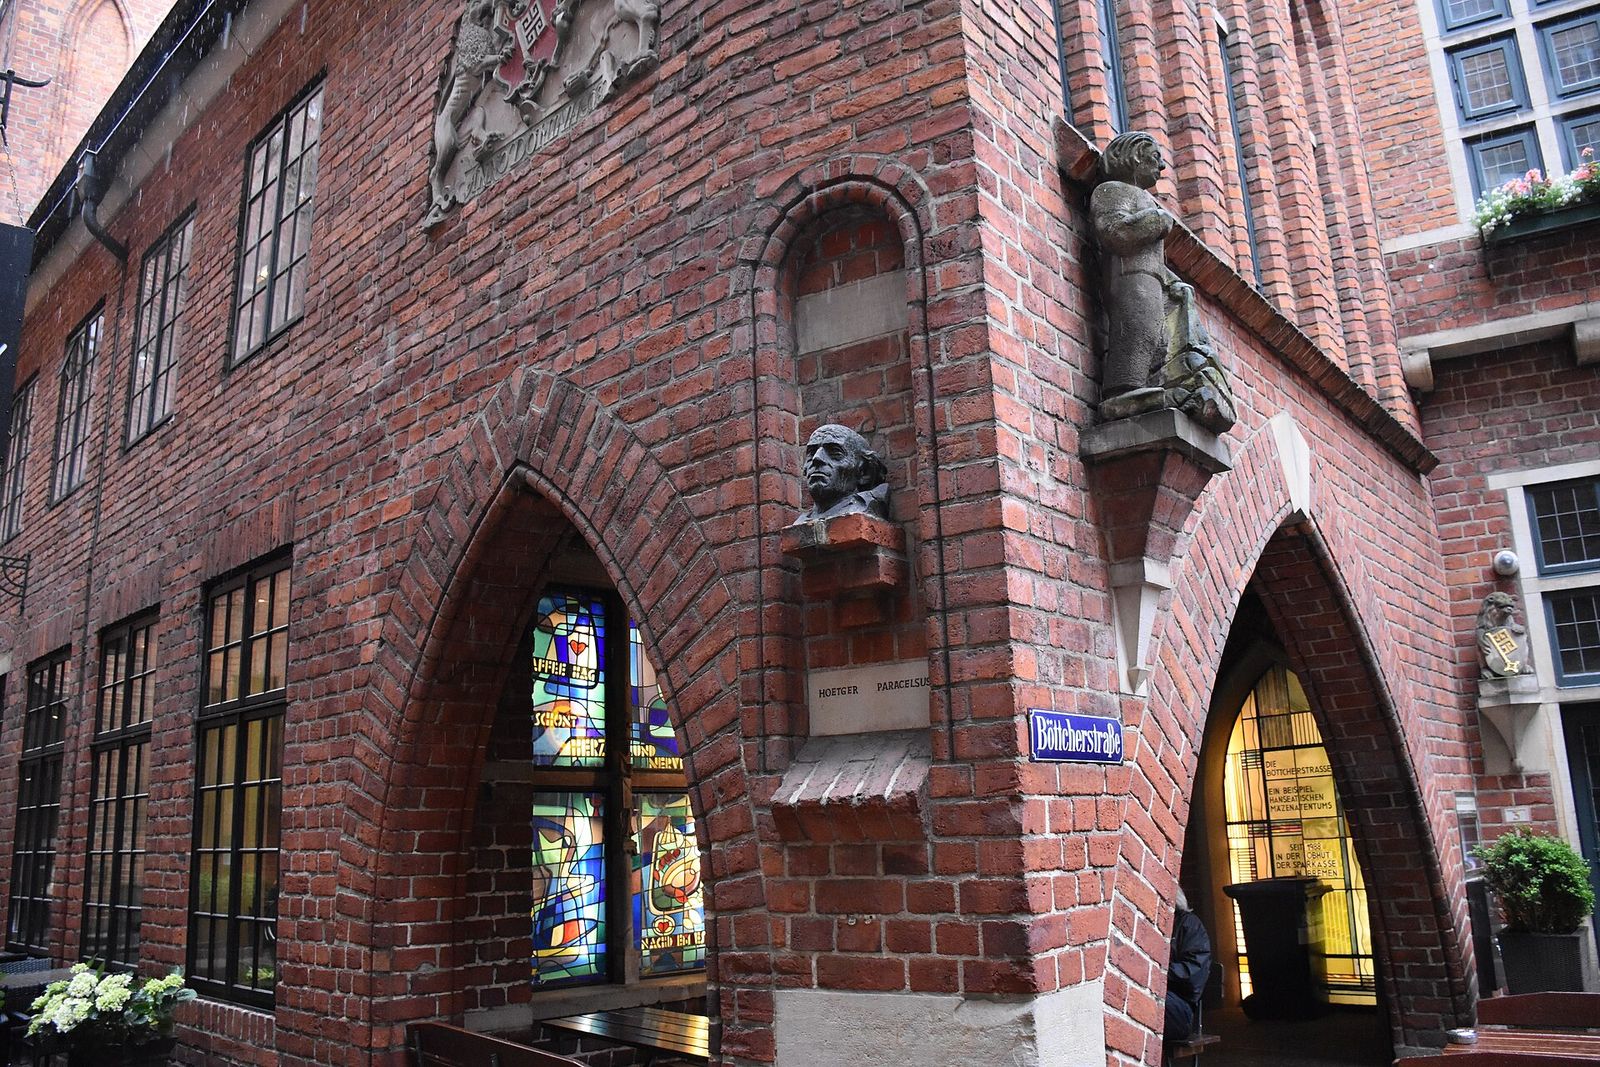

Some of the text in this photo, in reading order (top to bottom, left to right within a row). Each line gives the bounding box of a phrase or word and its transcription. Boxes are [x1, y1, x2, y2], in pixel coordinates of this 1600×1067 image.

[571, 665, 596, 682] HAG
[818, 677, 931, 698] HOETGER PARACELSUS
[1034, 715, 1121, 758] Böttcherstraße
[569, 737, 656, 757] HERZ UND
[1265, 760, 1277, 768] DIE
[1268, 785, 1315, 795] EIN BEISPIEL
[1269, 793, 1324, 804] HANSEATISCHEN
[1289, 843, 1304, 851] SEIT
[1286, 852, 1300, 860] DER
[1276, 859, 1336, 869] DER SPARKASSE
